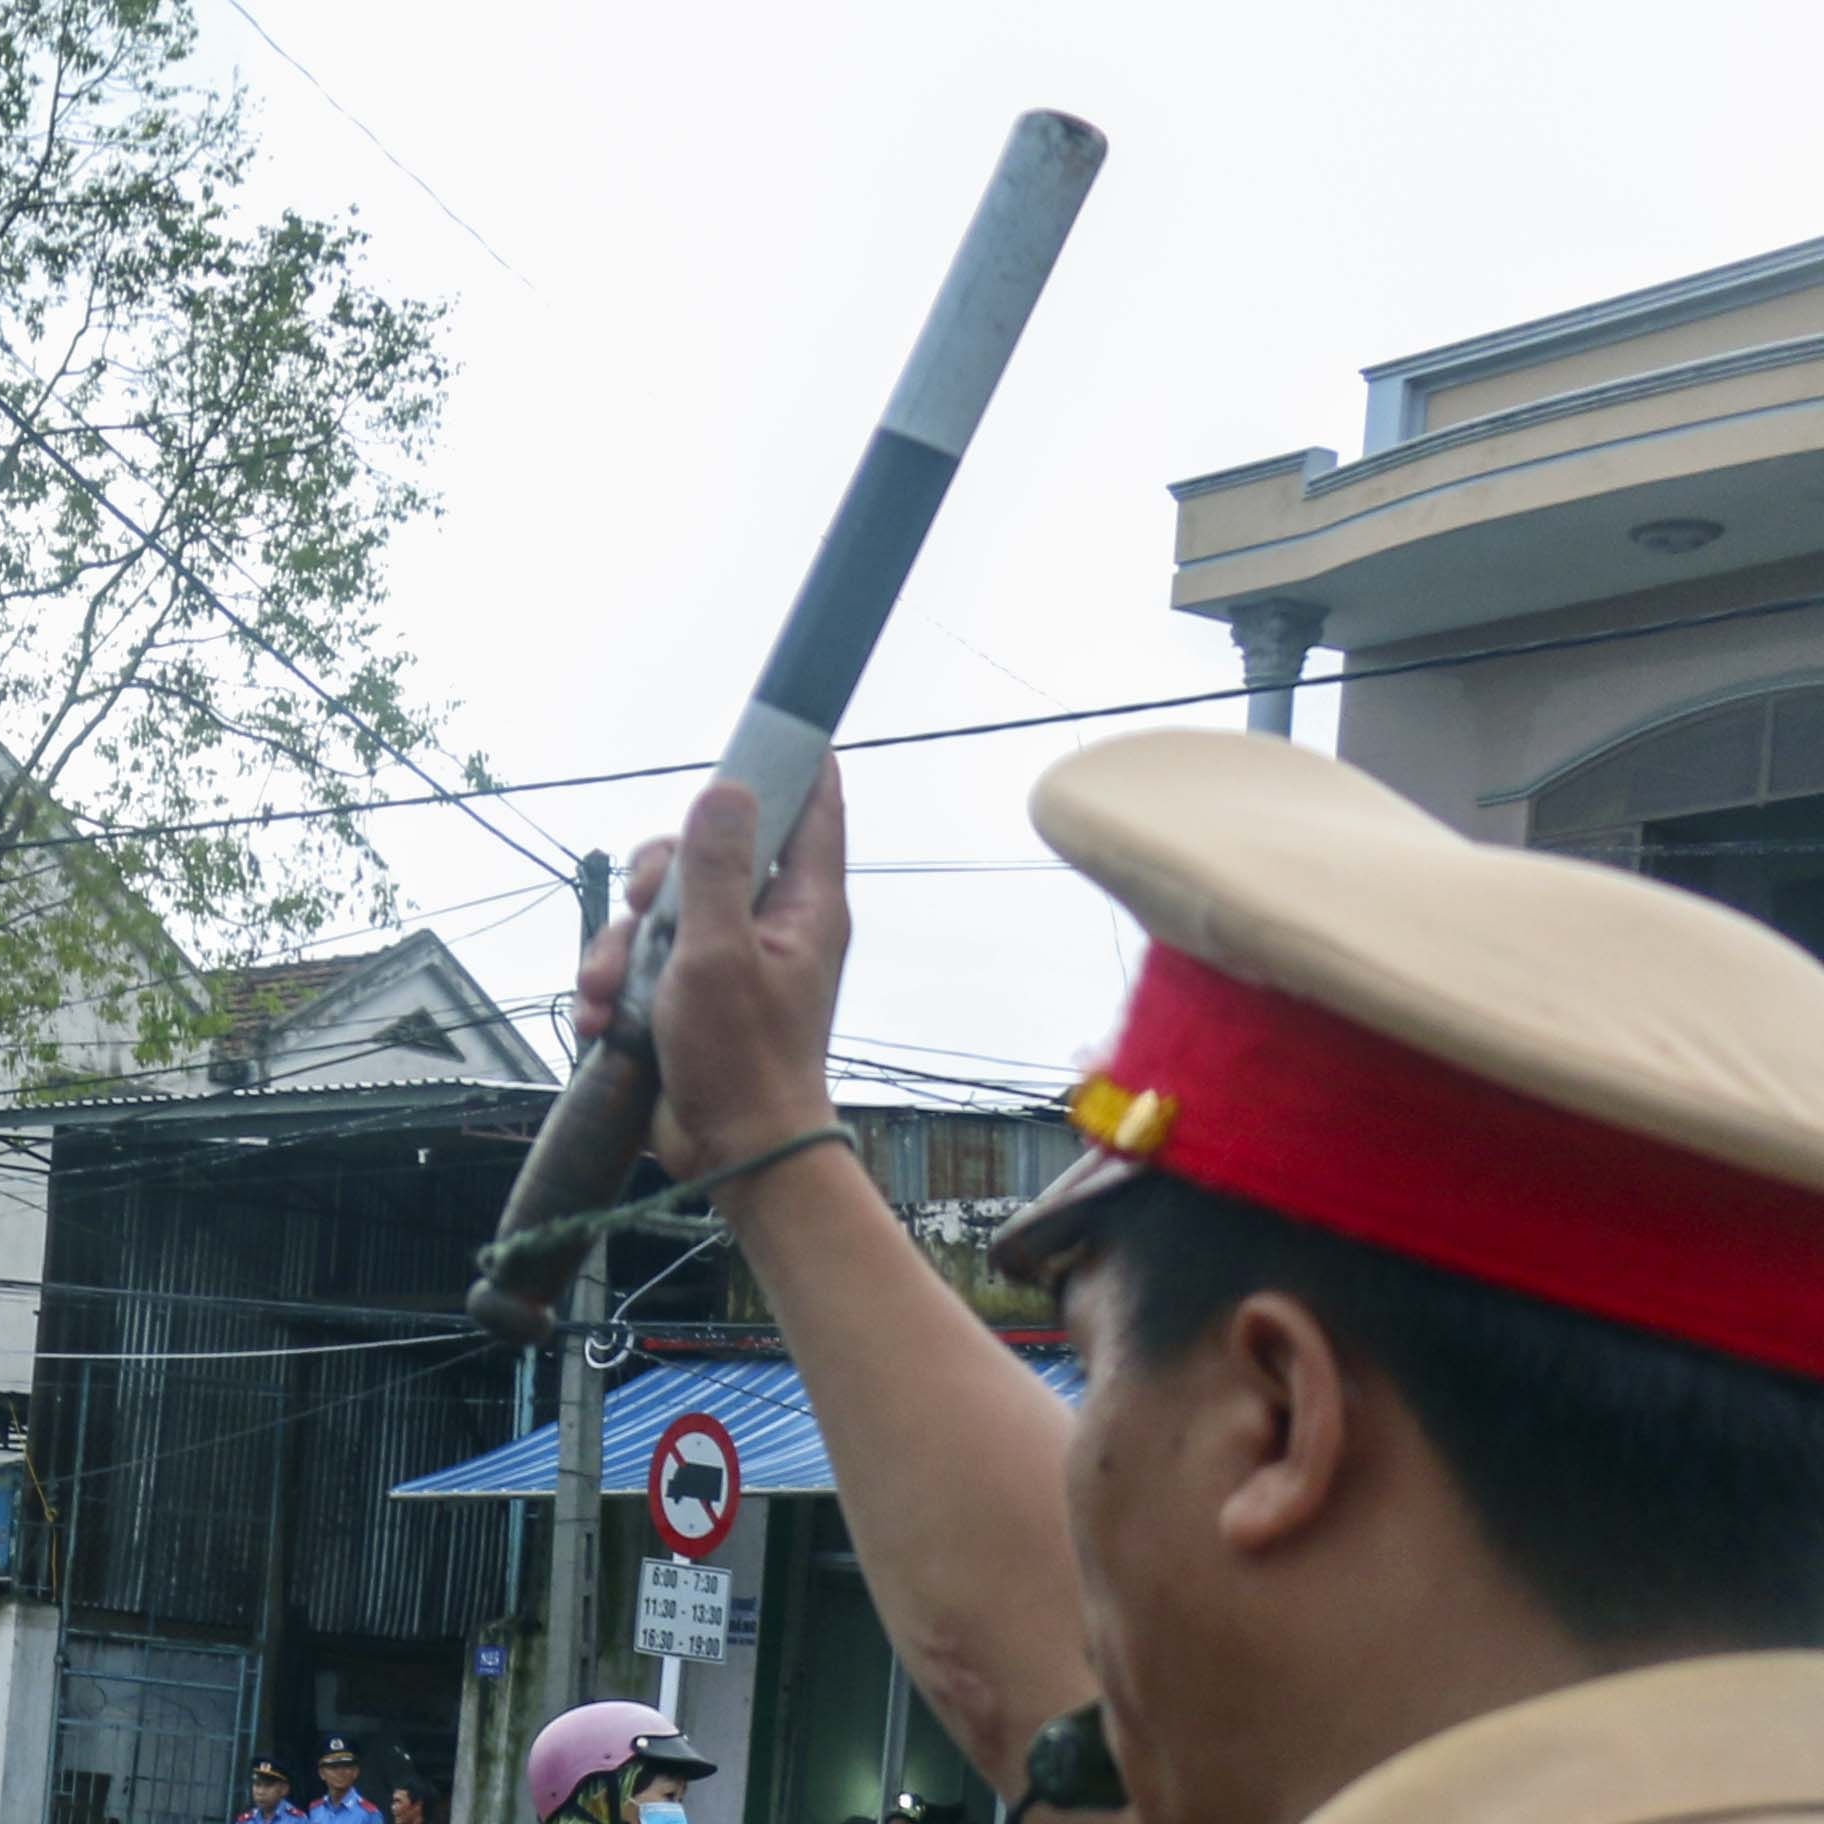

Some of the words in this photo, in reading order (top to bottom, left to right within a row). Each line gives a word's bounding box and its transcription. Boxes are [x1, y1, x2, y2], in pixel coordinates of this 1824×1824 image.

[652, 1567, 678, 1589] 6:00
[694, 1573, 718, 1595] 7:30
[644, 1597, 677, 1619] 11:30
[692, 1604, 722, 1626] 13:30
[641, 1628, 674, 1651] 16:30
[689, 1636, 720, 1657] 19:00
